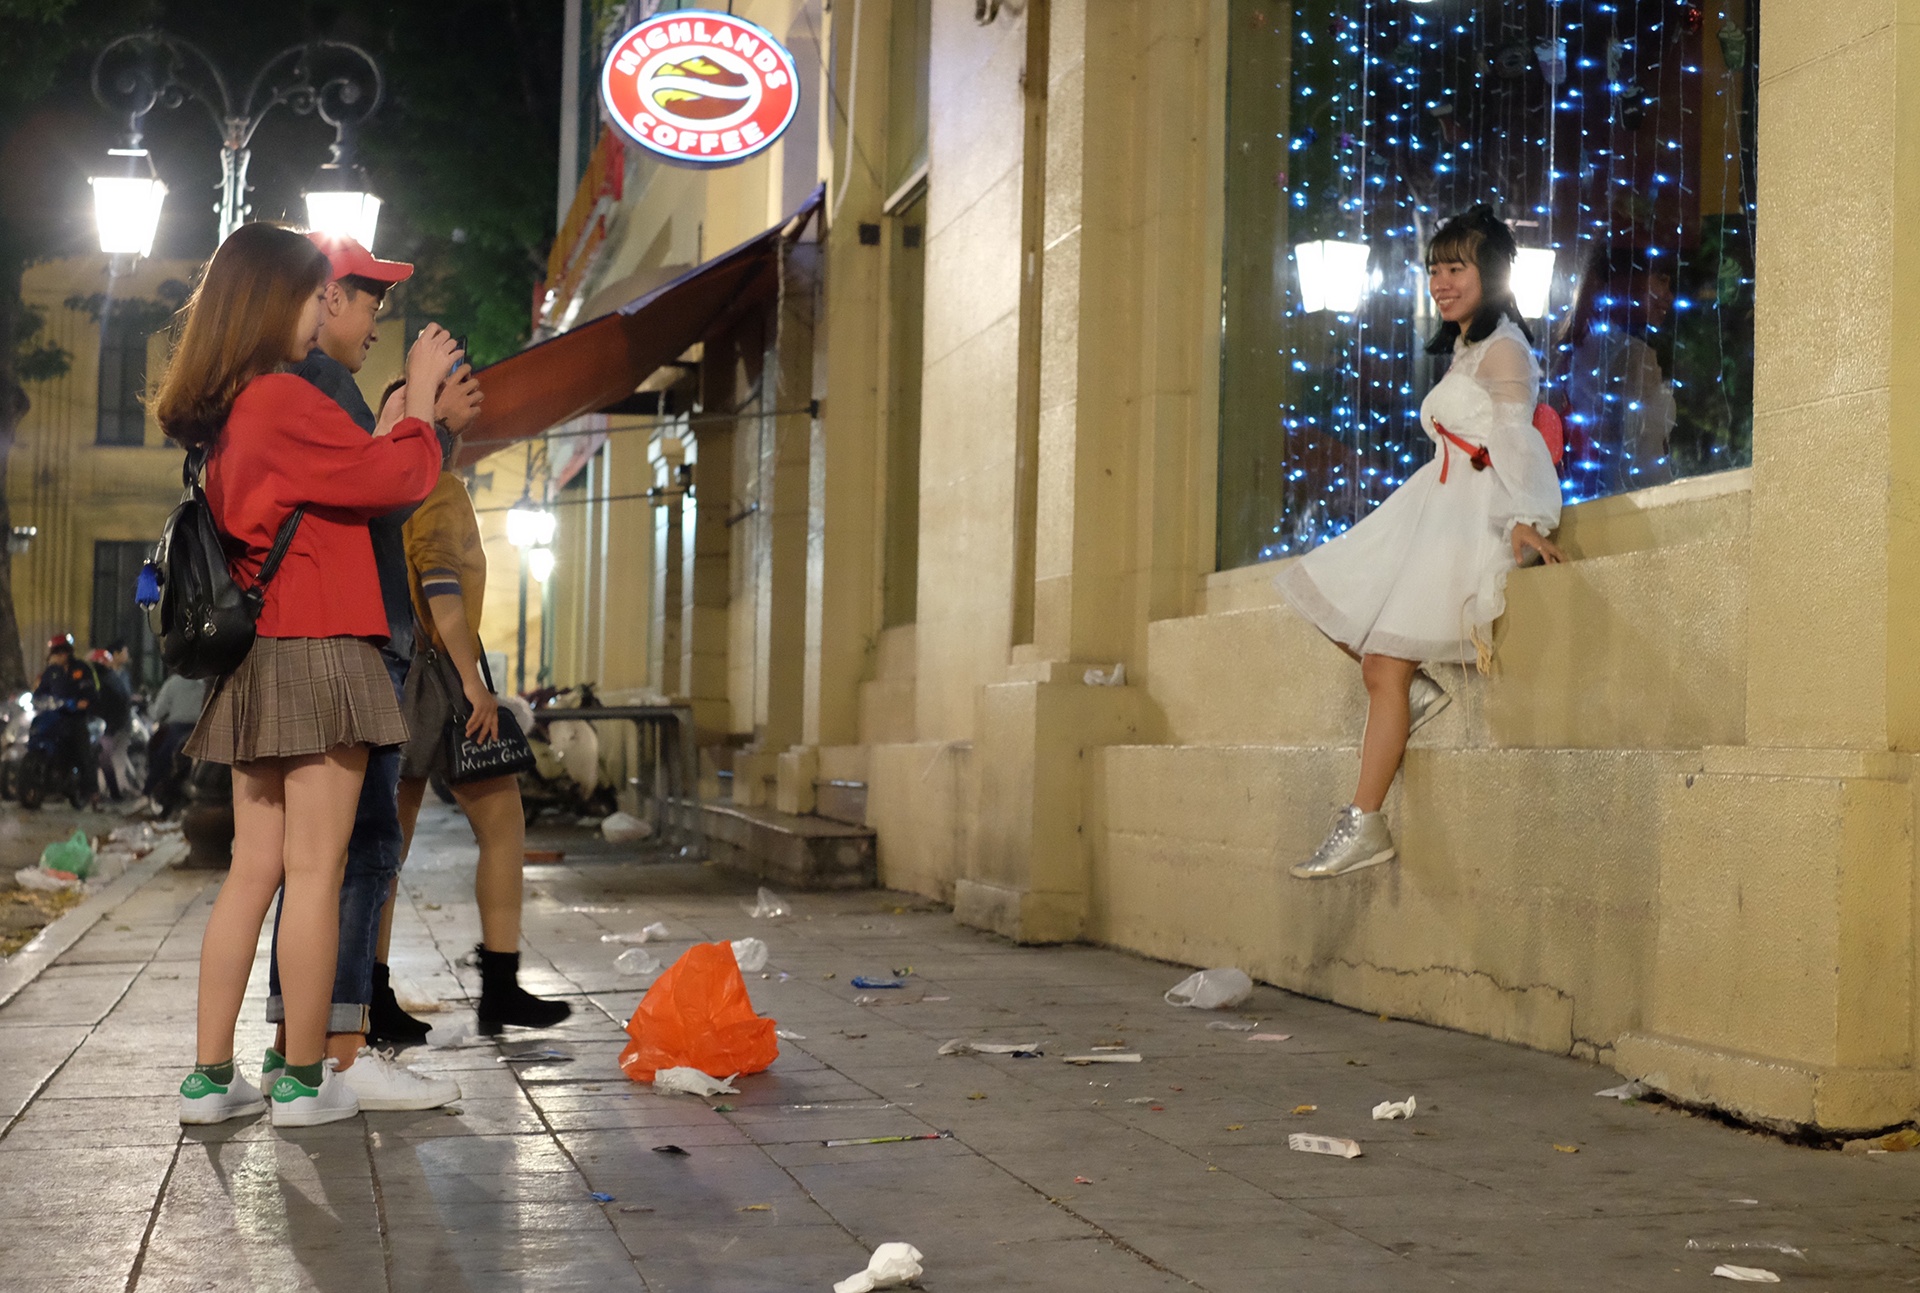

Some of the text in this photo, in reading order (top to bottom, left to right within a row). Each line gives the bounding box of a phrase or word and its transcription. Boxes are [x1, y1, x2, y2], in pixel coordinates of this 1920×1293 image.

[615, 21, 788, 89] HIGHLANDS
[632, 112, 765, 153] COFFEE
[461, 737, 517, 757] Fashion
[461, 747, 529, 771] Mini Girl
